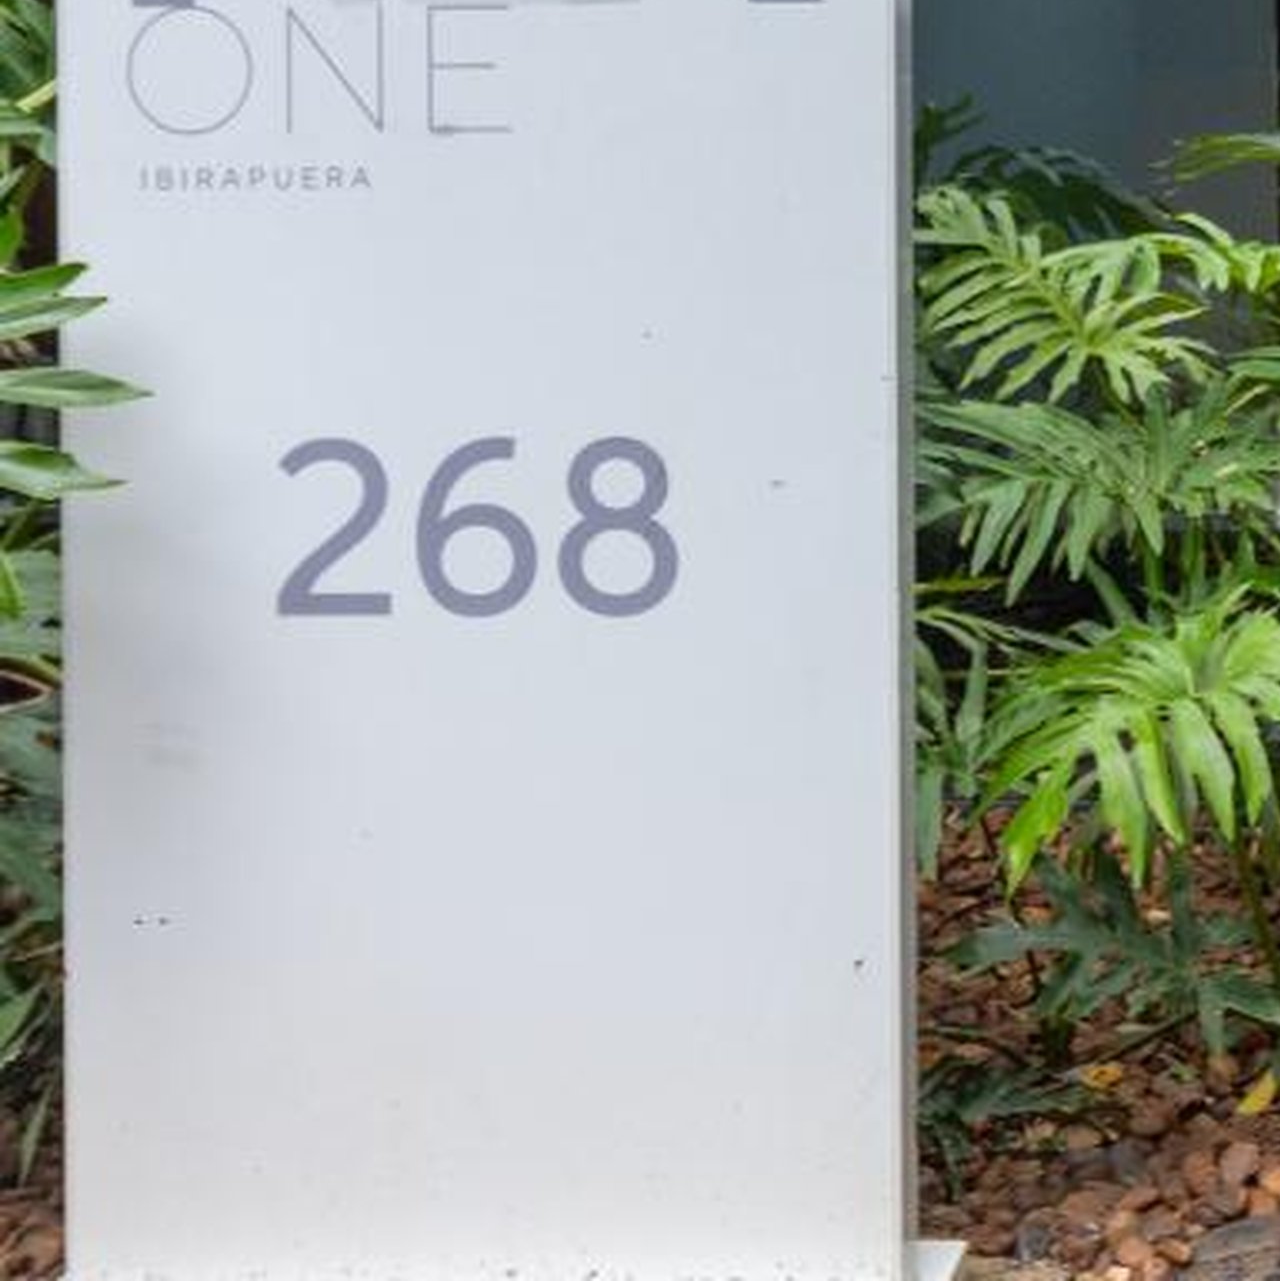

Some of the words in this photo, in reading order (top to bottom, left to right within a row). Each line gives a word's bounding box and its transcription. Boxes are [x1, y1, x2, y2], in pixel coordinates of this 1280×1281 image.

[126, 0, 513, 135] ONE
[138, 165, 373, 193] IBIRAPUERA
[276, 435, 679, 618] 268
